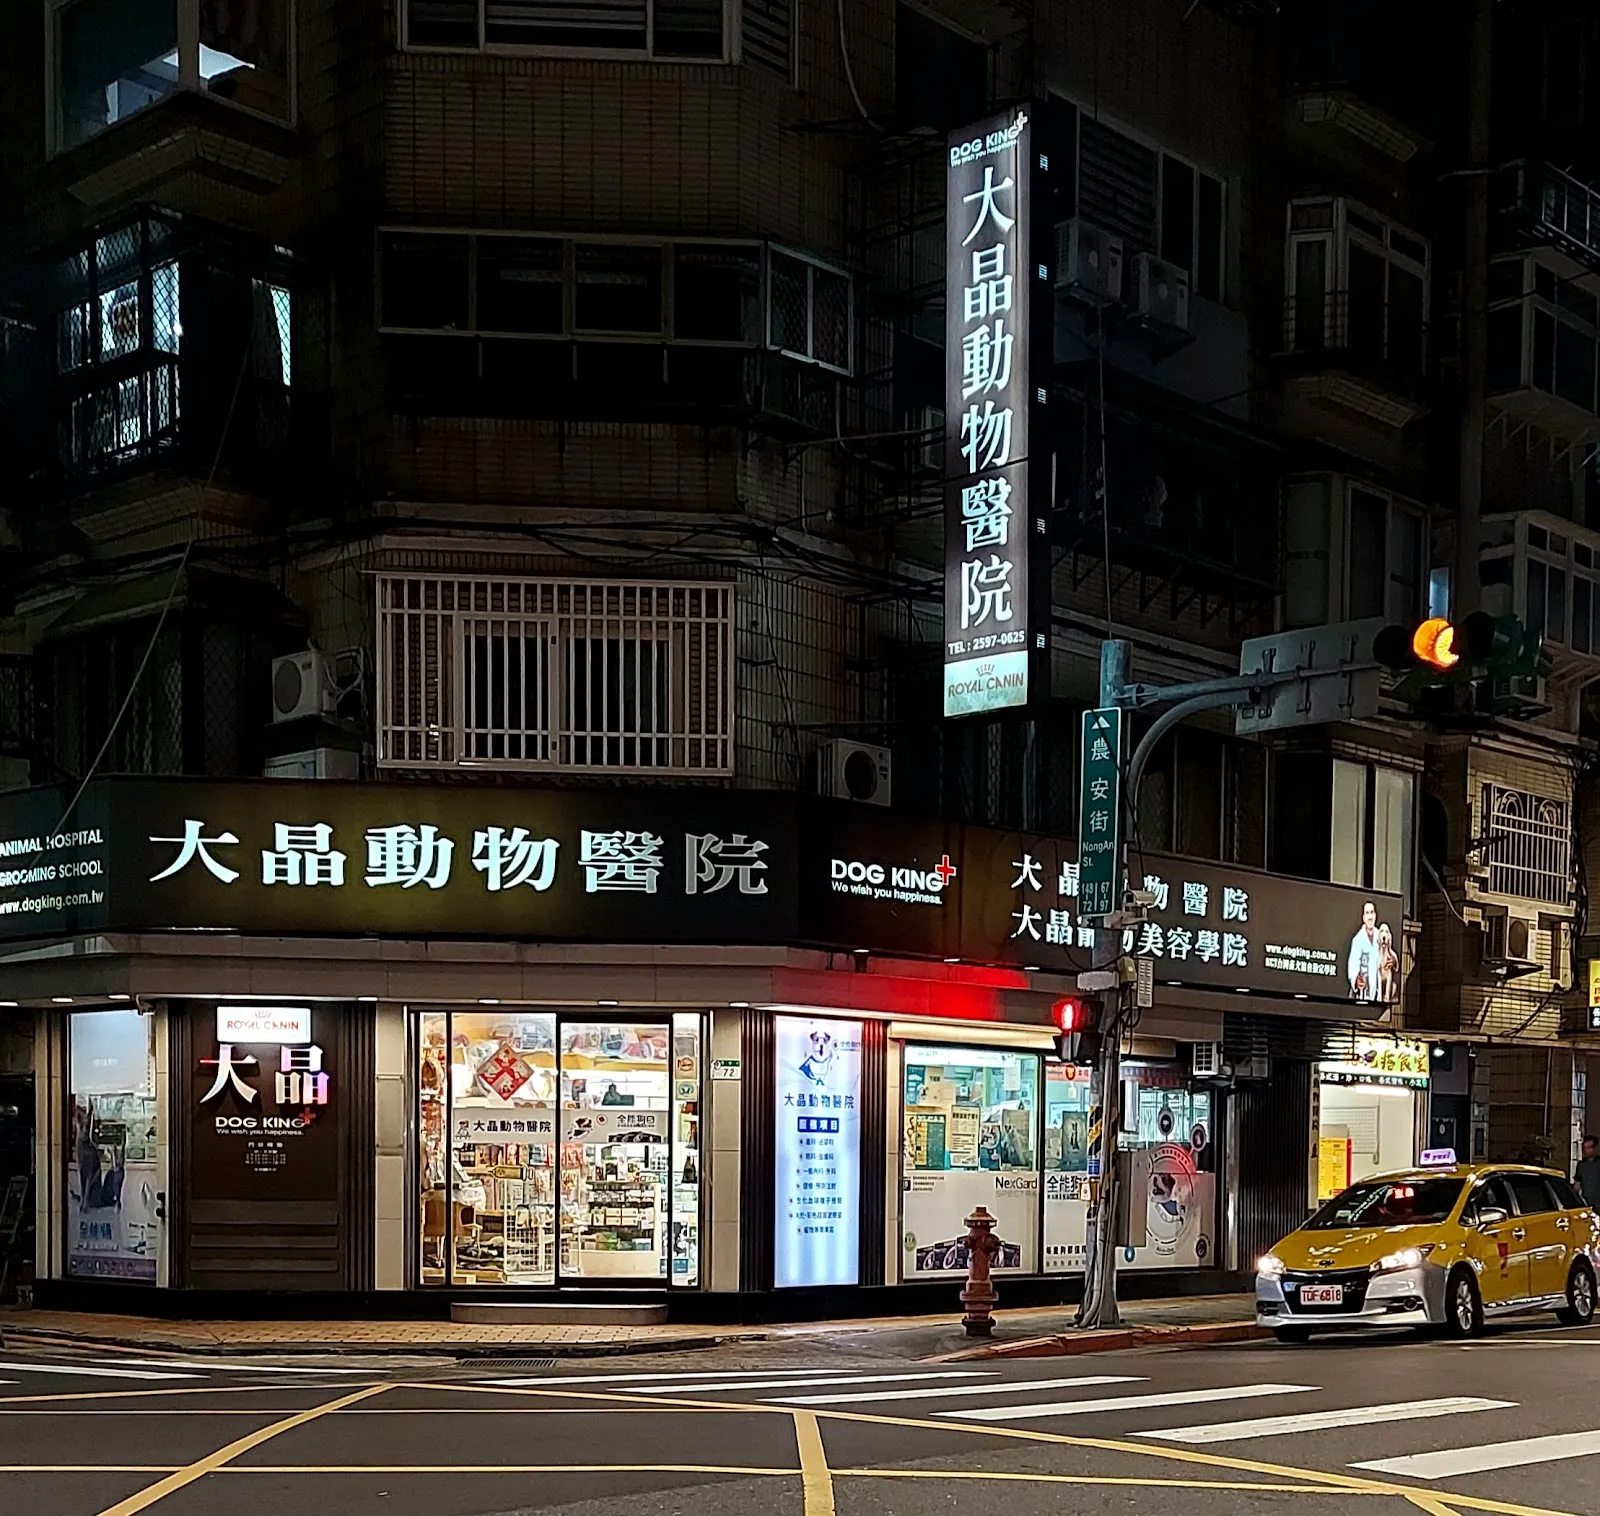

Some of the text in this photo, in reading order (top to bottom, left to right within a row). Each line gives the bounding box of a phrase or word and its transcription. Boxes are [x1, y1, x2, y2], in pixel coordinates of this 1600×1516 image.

[951, 126, 1020, 161] DOG KING
[961, 166, 1015, 630] 大晶動物醫院
[972, 630, 1025, 651] 2597-0625
[949, 672, 1024, 698] ROYAL CANIN
[1090, 737, 1110, 833] 農安街
[0, 828, 104, 857] ANIMAL HOSPITAL
[1082, 841, 1114, 853] NongAn
[148, 818, 771, 897] 大晶動物醫院
[1082, 857, 1094, 867] St.
[0, 859, 104, 887] GROOMING SCHOOL
[831, 858, 944, 892] DOG KING
[831, 880, 943, 905] We wish you happiness.
[1010, 853, 1249, 922] 大晶物醫院
[1100, 881, 1110, 894] 67
[1082, 899, 1110, 913] 72 97
[227, 1020, 299, 1031] ROYAL CANIN
[199, 1043, 330, 1105] 大晶
[723, 1068, 735, 1077] 72
[784, 1092, 855, 1109] 大晶動物醫院
[215, 1116, 306, 1129] DOG KING
[230, 1128, 248, 1136] wish
[264, 1128, 305, 1136] happiness.
[473, 1120, 552, 1133] 大晶動物醫院
[995, 1176, 1038, 1190] NexGard
